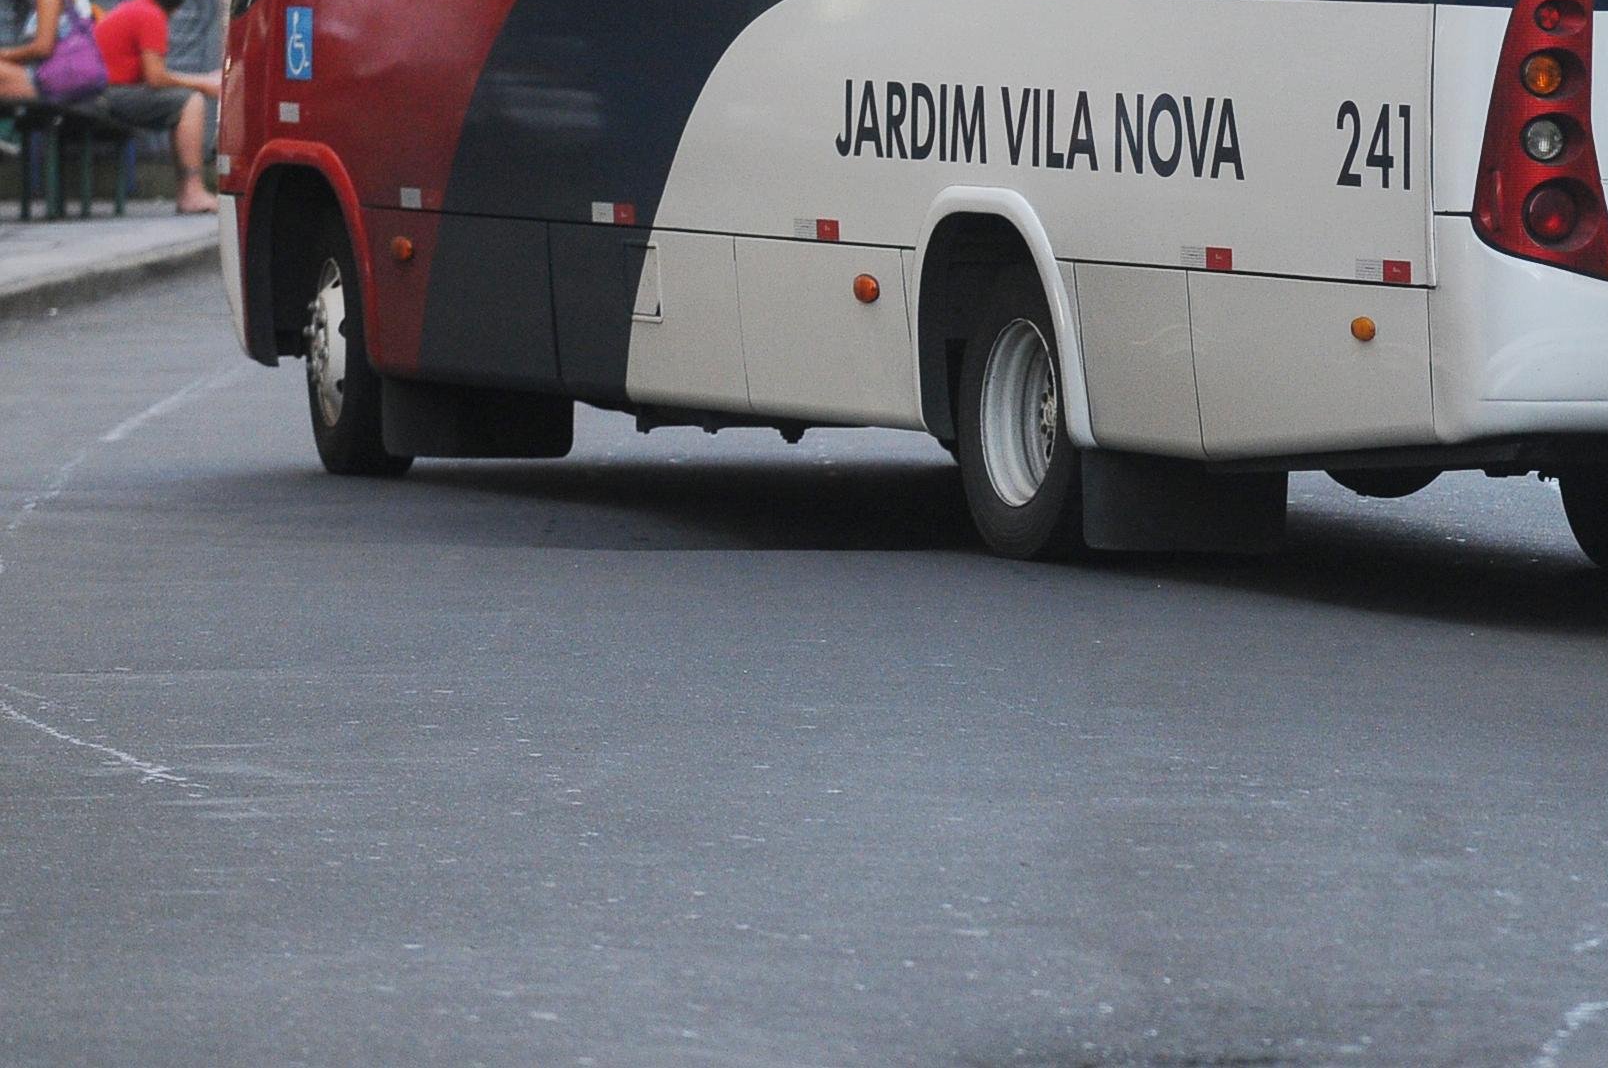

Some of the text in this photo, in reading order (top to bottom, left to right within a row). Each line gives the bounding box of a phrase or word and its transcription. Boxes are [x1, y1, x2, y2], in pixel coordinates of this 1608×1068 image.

[835, 78, 1245, 181] JARDIM VILA NOVA
[1336, 100, 1411, 191] 241
